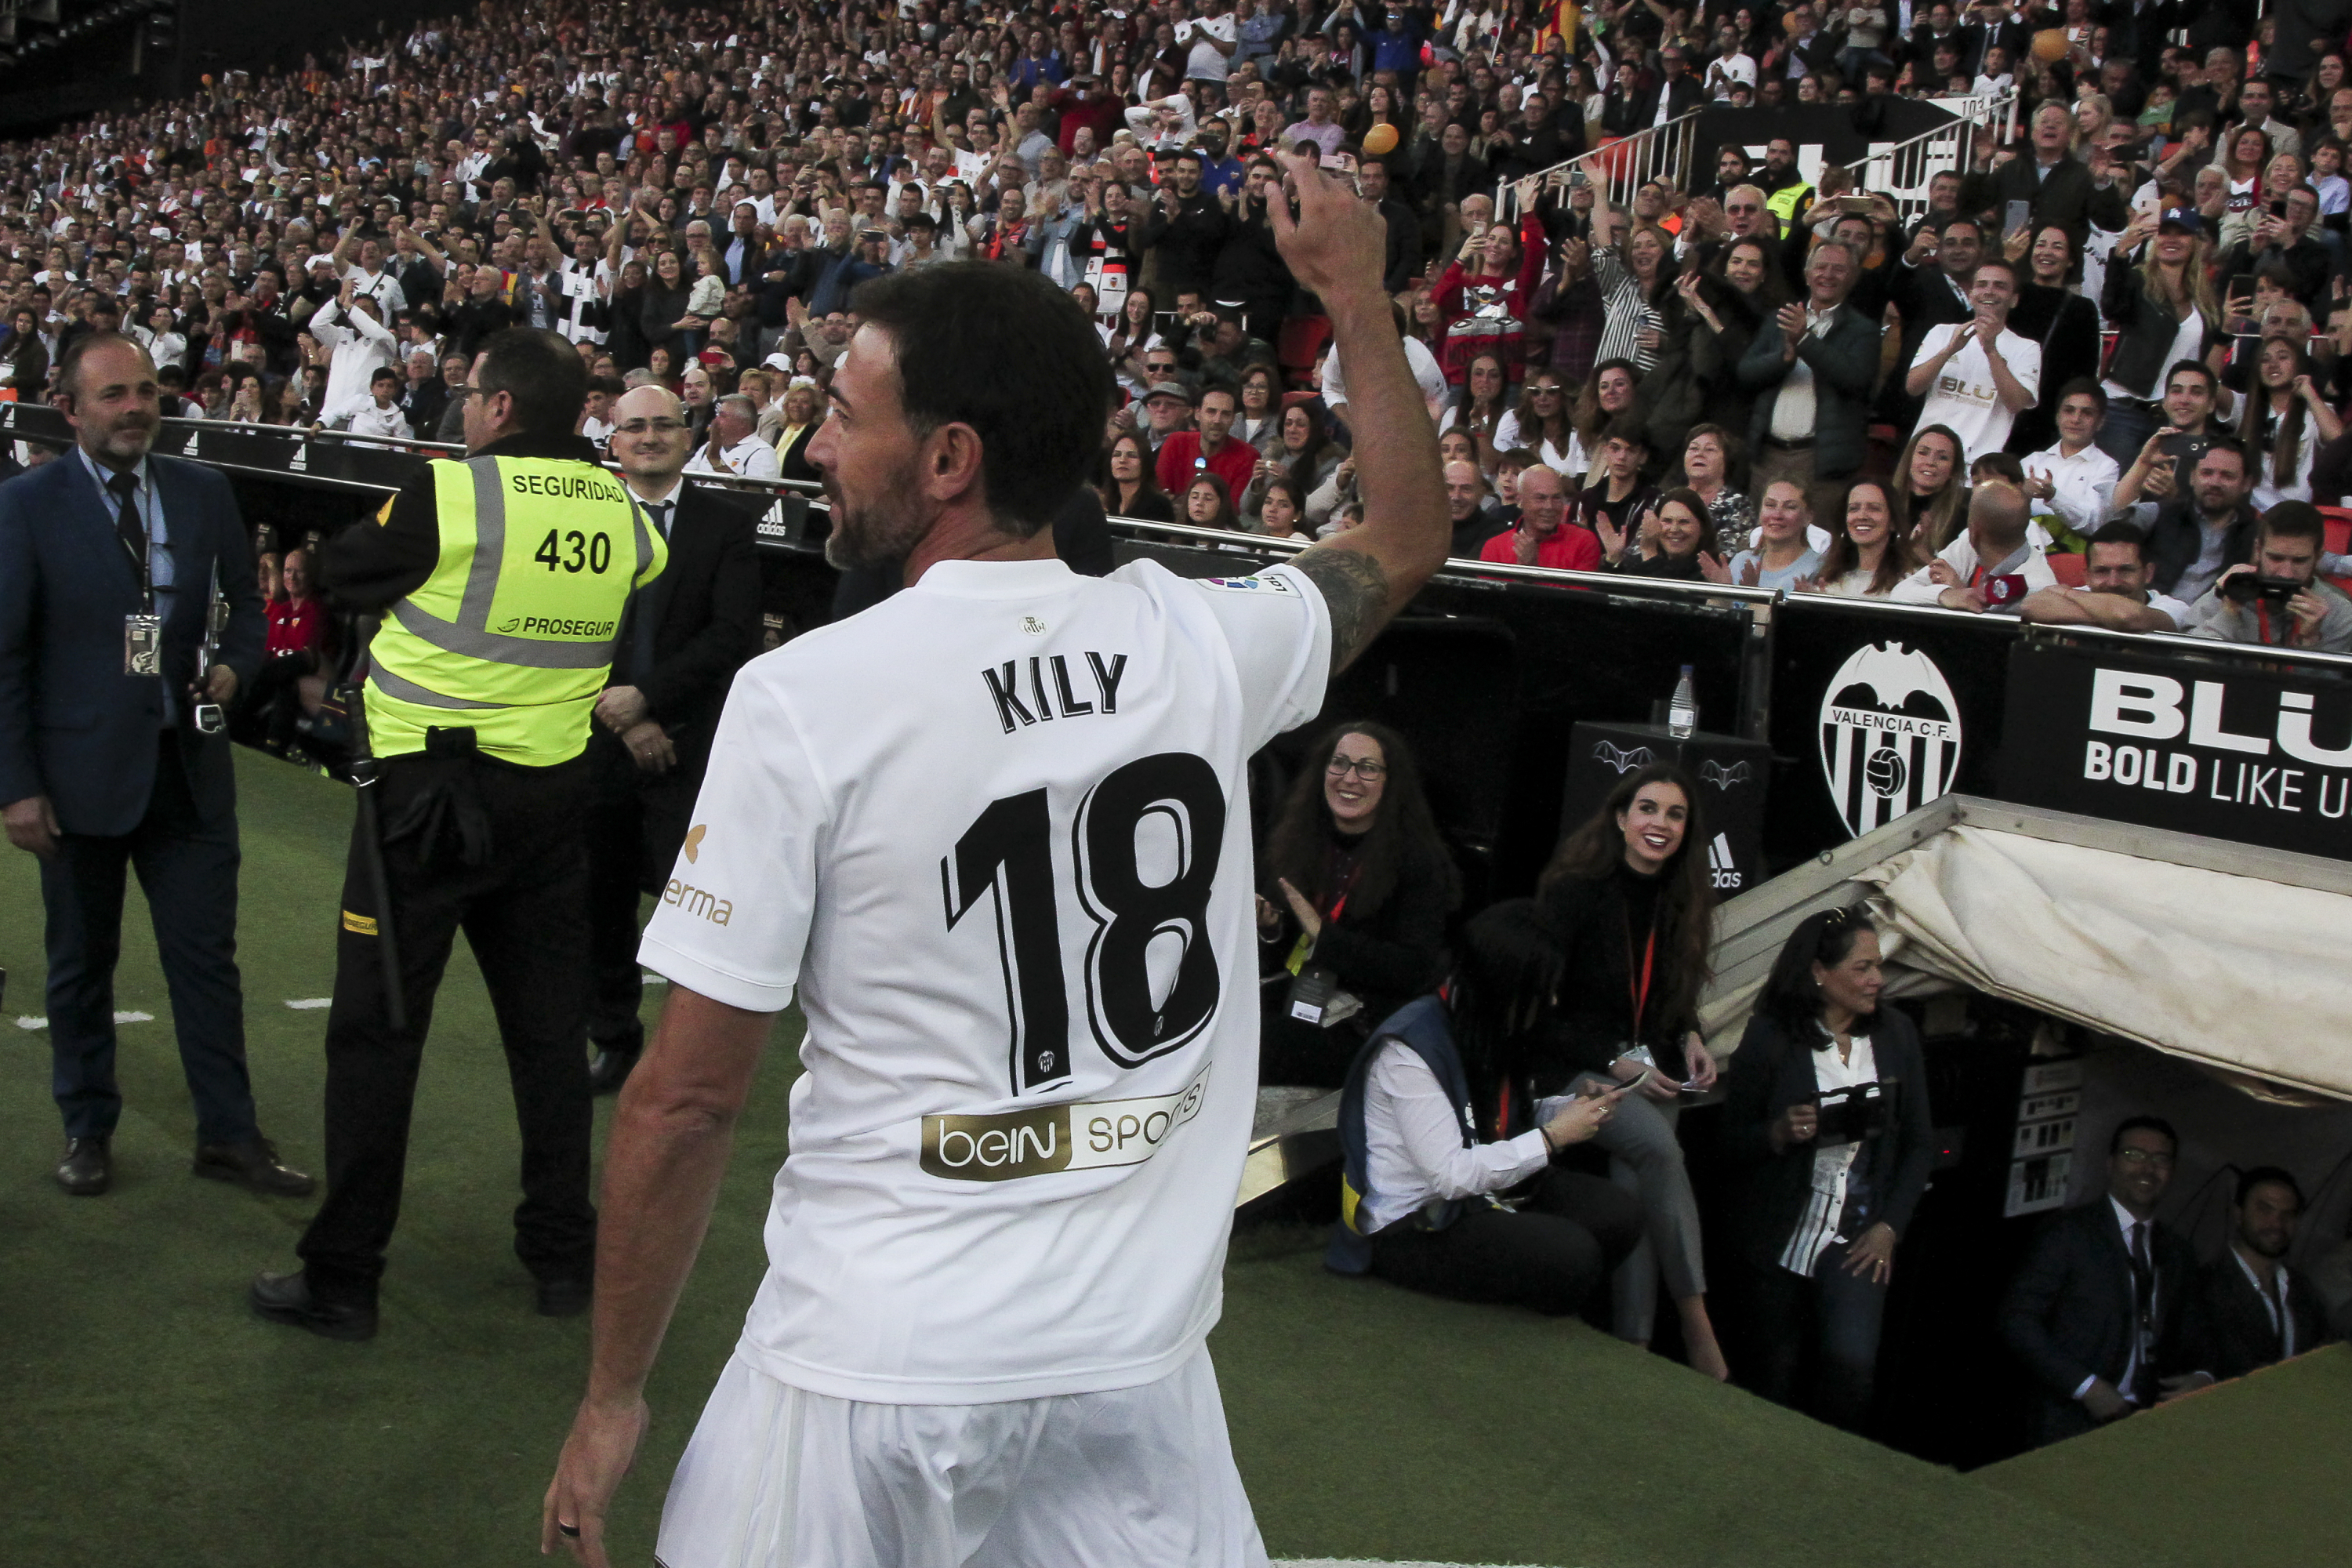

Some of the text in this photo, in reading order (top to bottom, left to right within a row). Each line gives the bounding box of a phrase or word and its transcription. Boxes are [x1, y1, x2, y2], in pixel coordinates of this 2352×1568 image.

[513, 475, 624, 503] SEGURIDAD
[535, 528, 611, 574] 430
[523, 617, 615, 637] PROSEGUR
[981, 652, 1128, 735] KILY
[1833, 710, 1951, 738] VALENCIA C.F.
[2084, 740, 2352, 818] BOLD LIKE U
[940, 751, 1227, 1098] 18
[939, 1118, 1057, 1167] beIN
